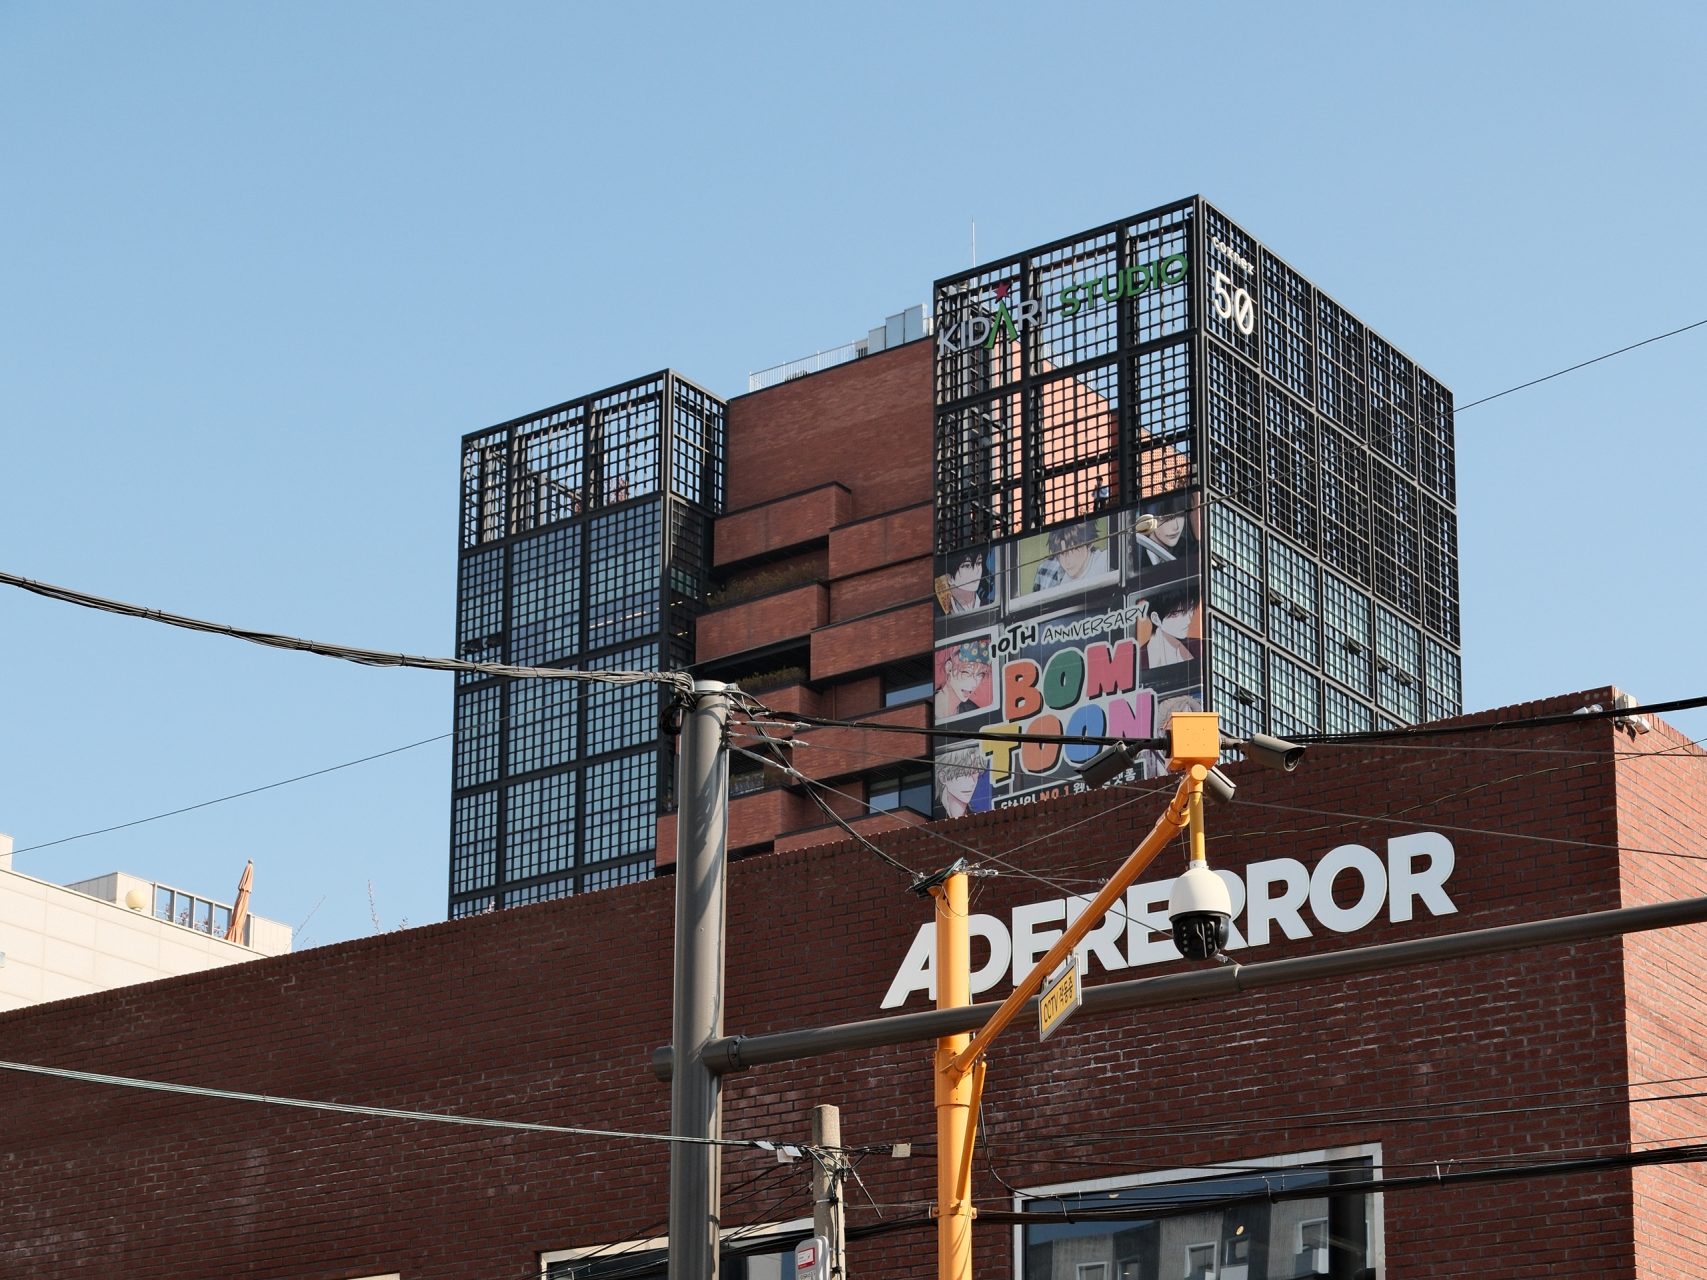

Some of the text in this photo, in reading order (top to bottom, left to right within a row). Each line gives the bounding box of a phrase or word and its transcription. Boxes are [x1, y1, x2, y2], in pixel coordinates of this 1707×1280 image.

[1059, 254, 1189, 317] STUDIO
[1214, 269, 1254, 335] 50
[991, 603, 1150, 660] 10TH ANNIVERSARY
[1000, 640, 1138, 722] BOM
[978, 690, 1157, 785] TOON
[1043, 991, 1058, 1023] CCTV
